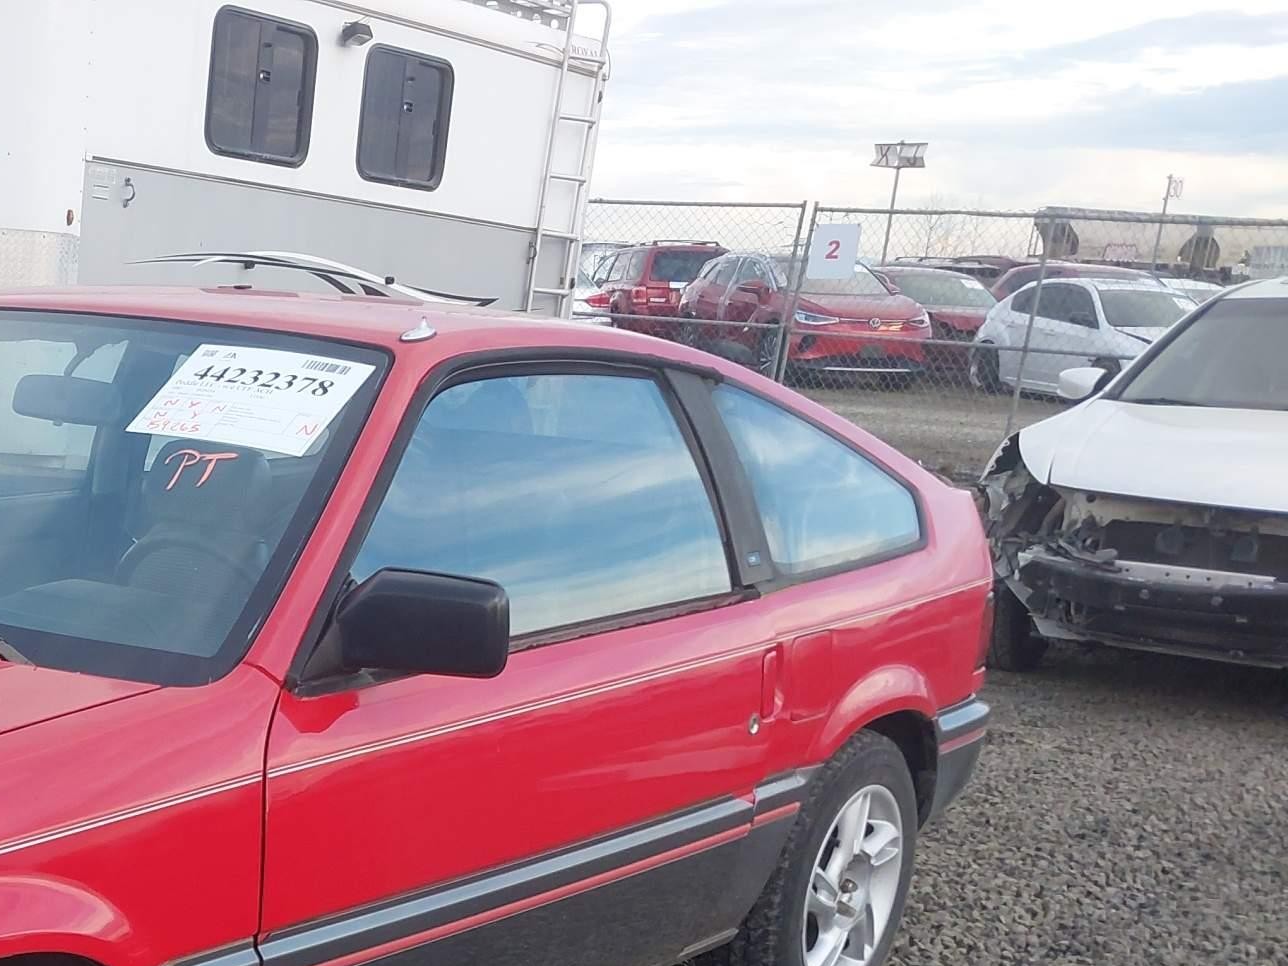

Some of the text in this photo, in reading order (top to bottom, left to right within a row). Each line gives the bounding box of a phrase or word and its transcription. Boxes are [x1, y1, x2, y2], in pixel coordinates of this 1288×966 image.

[825, 240, 841, 259] 2
[193, 364, 335, 397] 44232378
[164, 449, 239, 491] PT
